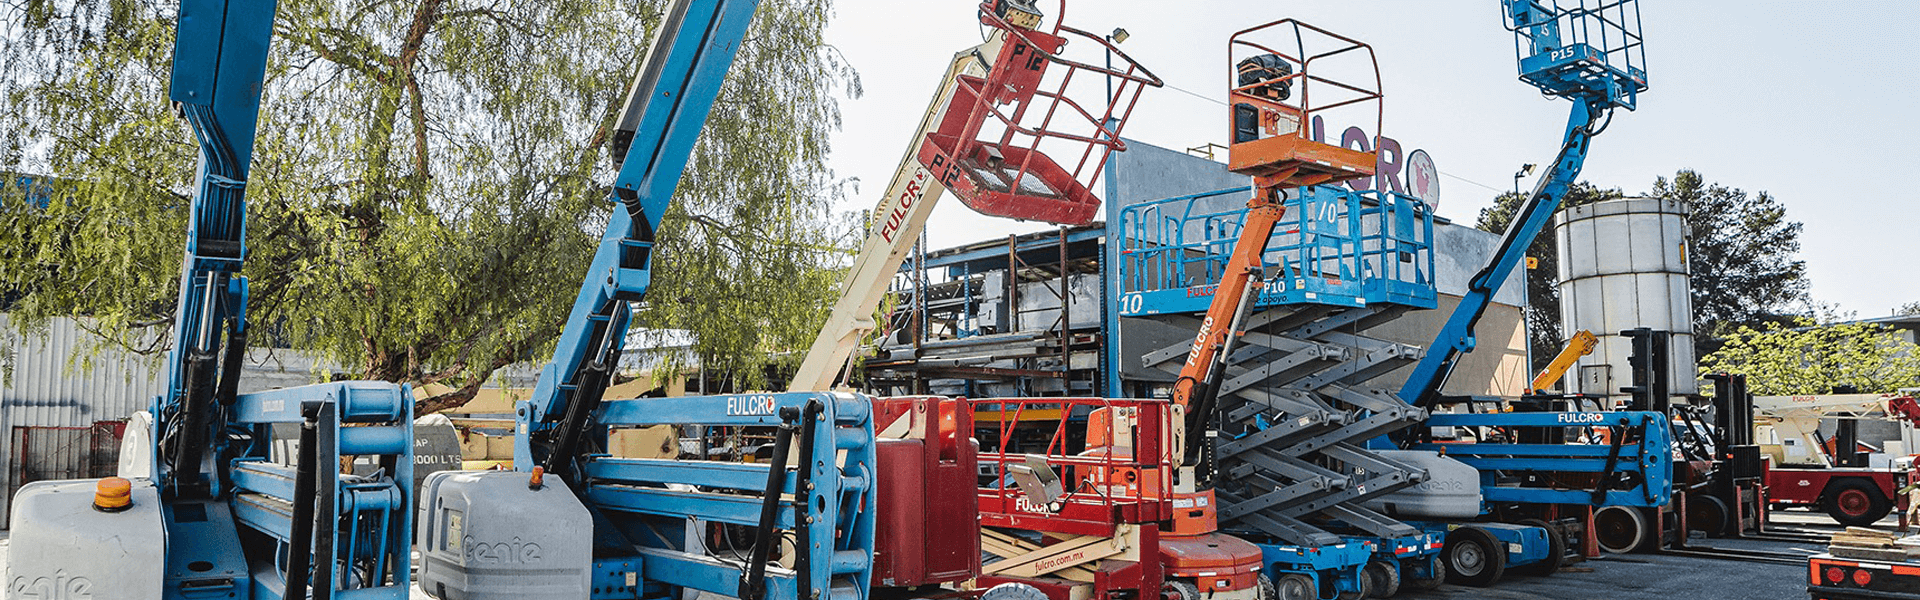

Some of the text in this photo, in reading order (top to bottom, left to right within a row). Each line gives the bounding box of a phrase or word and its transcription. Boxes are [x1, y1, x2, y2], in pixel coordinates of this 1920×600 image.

[1009, 43, 1027, 62] P
[1550, 46, 1575, 62] P15
[929, 152, 945, 171] P
[1263, 280, 1286, 294] P10
[1120, 293, 1143, 314] 10
[1186, 315, 1214, 368] FULCRO
[726, 395, 776, 416] FULCRO
[1557, 412, 1604, 423] FULCRO
[413, 438, 432, 448] AP.
[462, 534, 542, 563] Genie
[1035, 551, 1085, 574] fulcro.com.mx
[5, 567, 93, 600] enie
